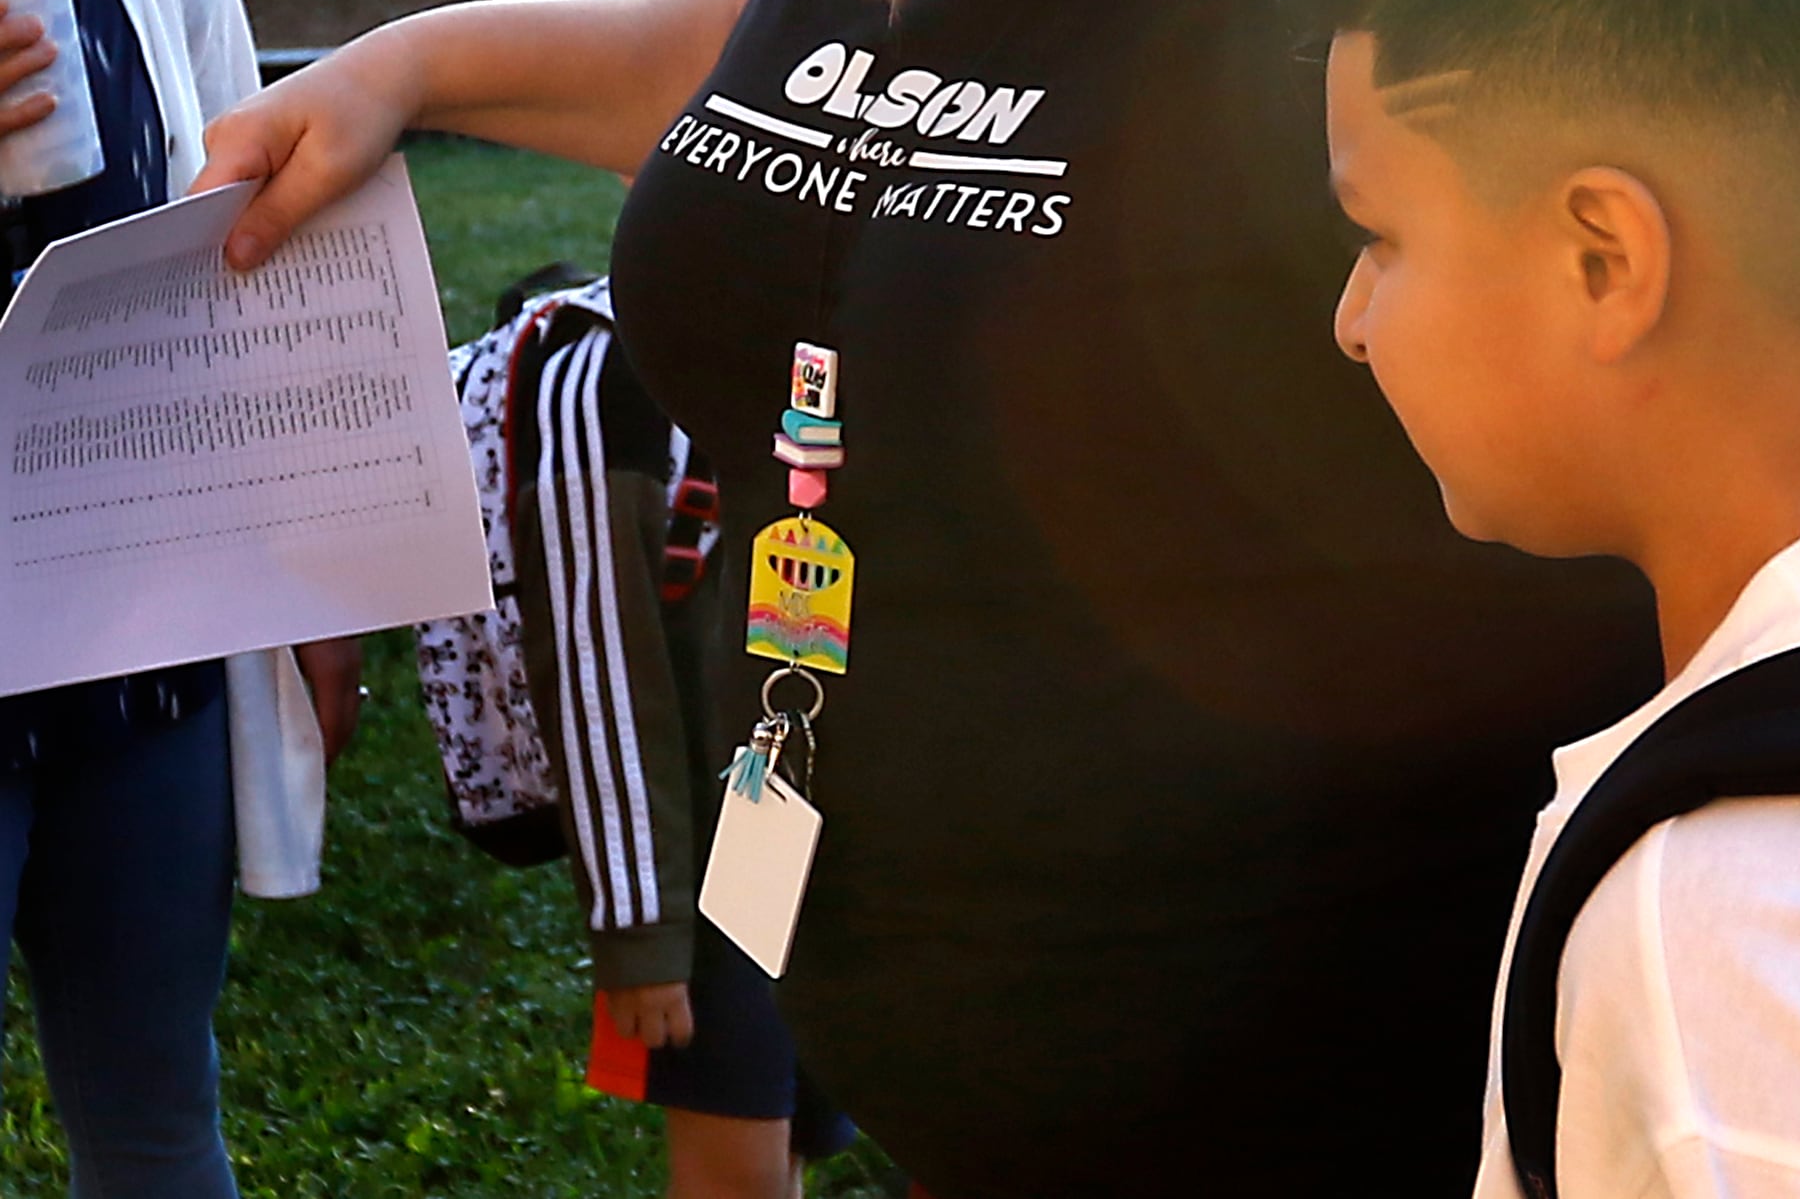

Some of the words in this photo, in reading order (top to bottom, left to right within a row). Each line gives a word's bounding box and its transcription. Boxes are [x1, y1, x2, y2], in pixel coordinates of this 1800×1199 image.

[785, 43, 1045, 144] OLSON
[661, 115, 867, 212] EVERYONE
[872, 184, 1071, 236] MATTERS
